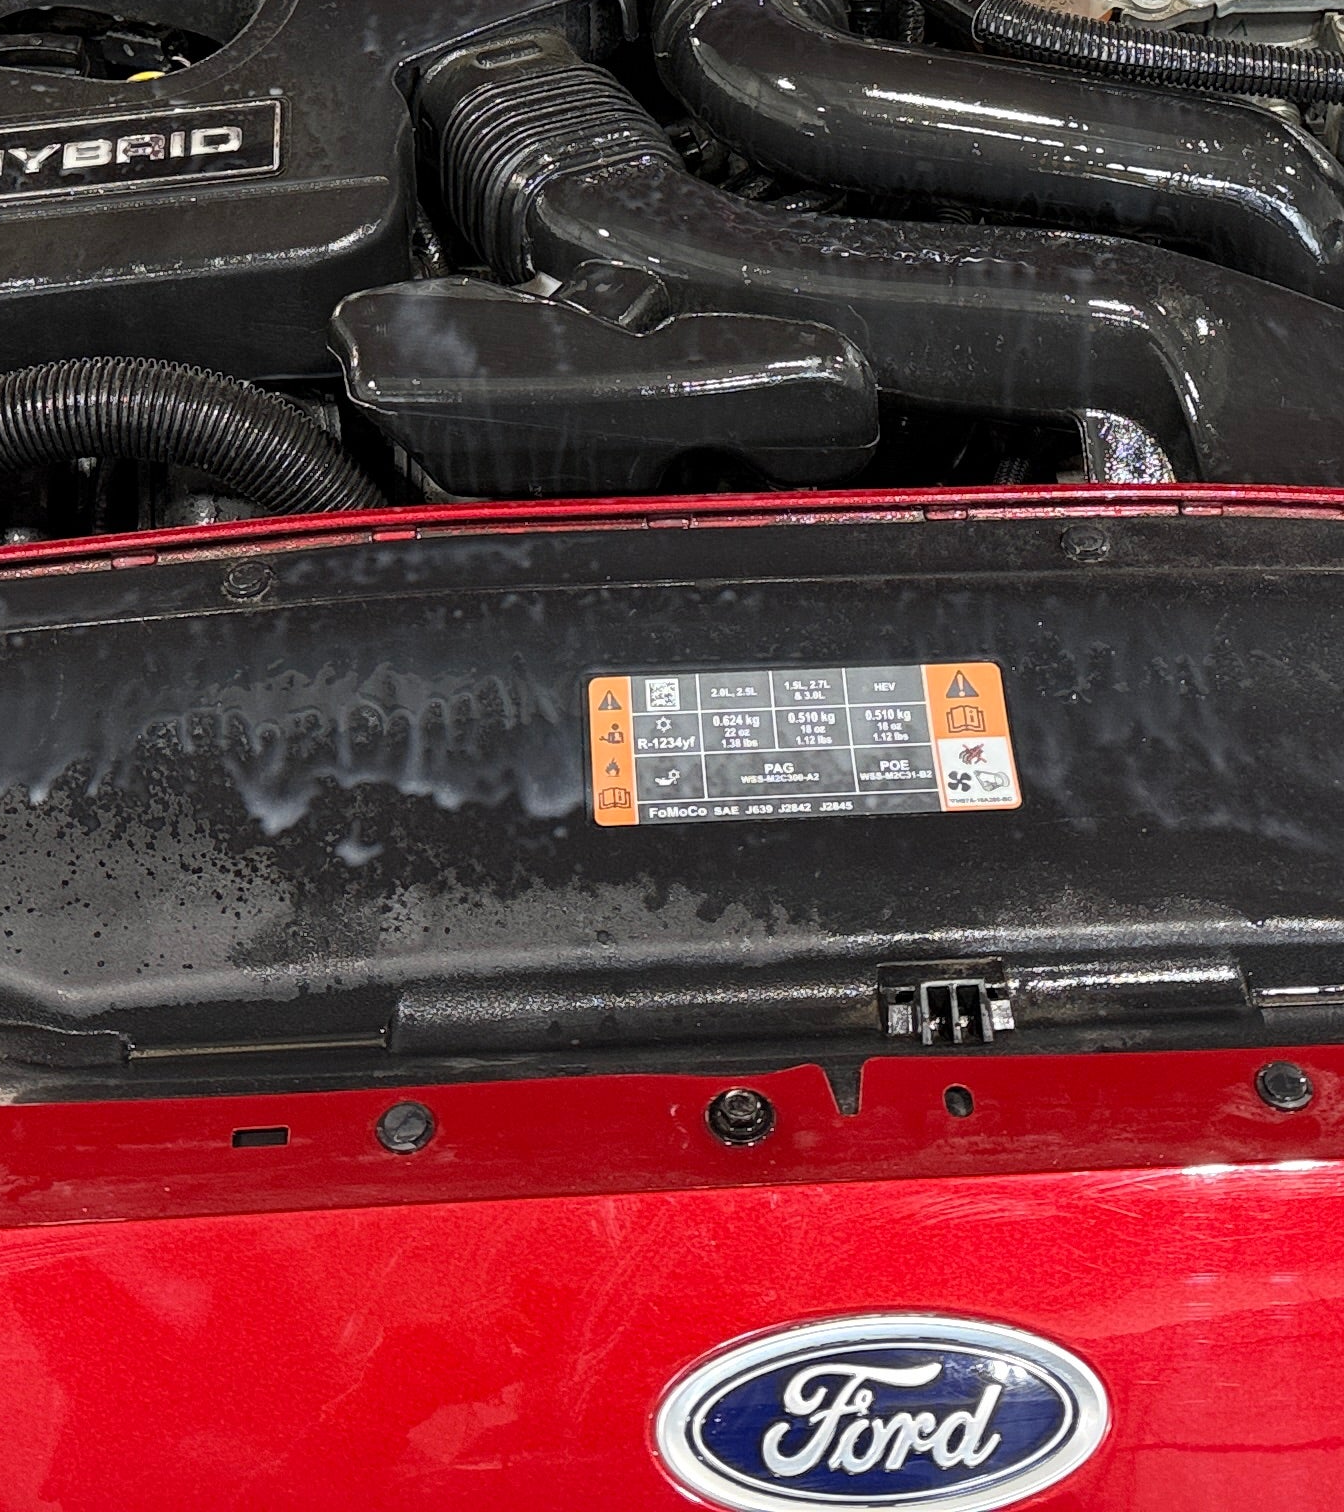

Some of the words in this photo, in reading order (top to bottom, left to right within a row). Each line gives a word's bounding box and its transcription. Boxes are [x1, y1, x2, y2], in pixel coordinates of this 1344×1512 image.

[809, 680, 831, 689] 2.7L
[874, 682, 896, 692] HEV
[788, 712, 818, 724] 0.510
[821, 712, 836, 725] kg
[865, 709, 895, 721] 0.510
[897, 709, 912, 722] kg
[713, 715, 743, 727] 0.624
[745, 715, 760, 727] kg
[814, 725, 826, 734] oz
[890, 722, 903, 731] oz
[724, 728, 737, 737] 22
[738, 729, 751, 737] oz
[873, 732, 892, 742] 1.12
[894, 732, 909, 741] lbs
[637, 736, 696, 750] R-1234yf
[743, 738, 759, 748] lbs
[796, 736, 816, 745] 1.12
[818, 735, 833, 744] lbs
[764, 763, 795, 774] PAG
[879, 759, 910, 771] POE
[649, 805, 708, 819] FoMoCo
[714, 806, 740, 816] SAE
[763, 1362, 1003, 1478] Ford
